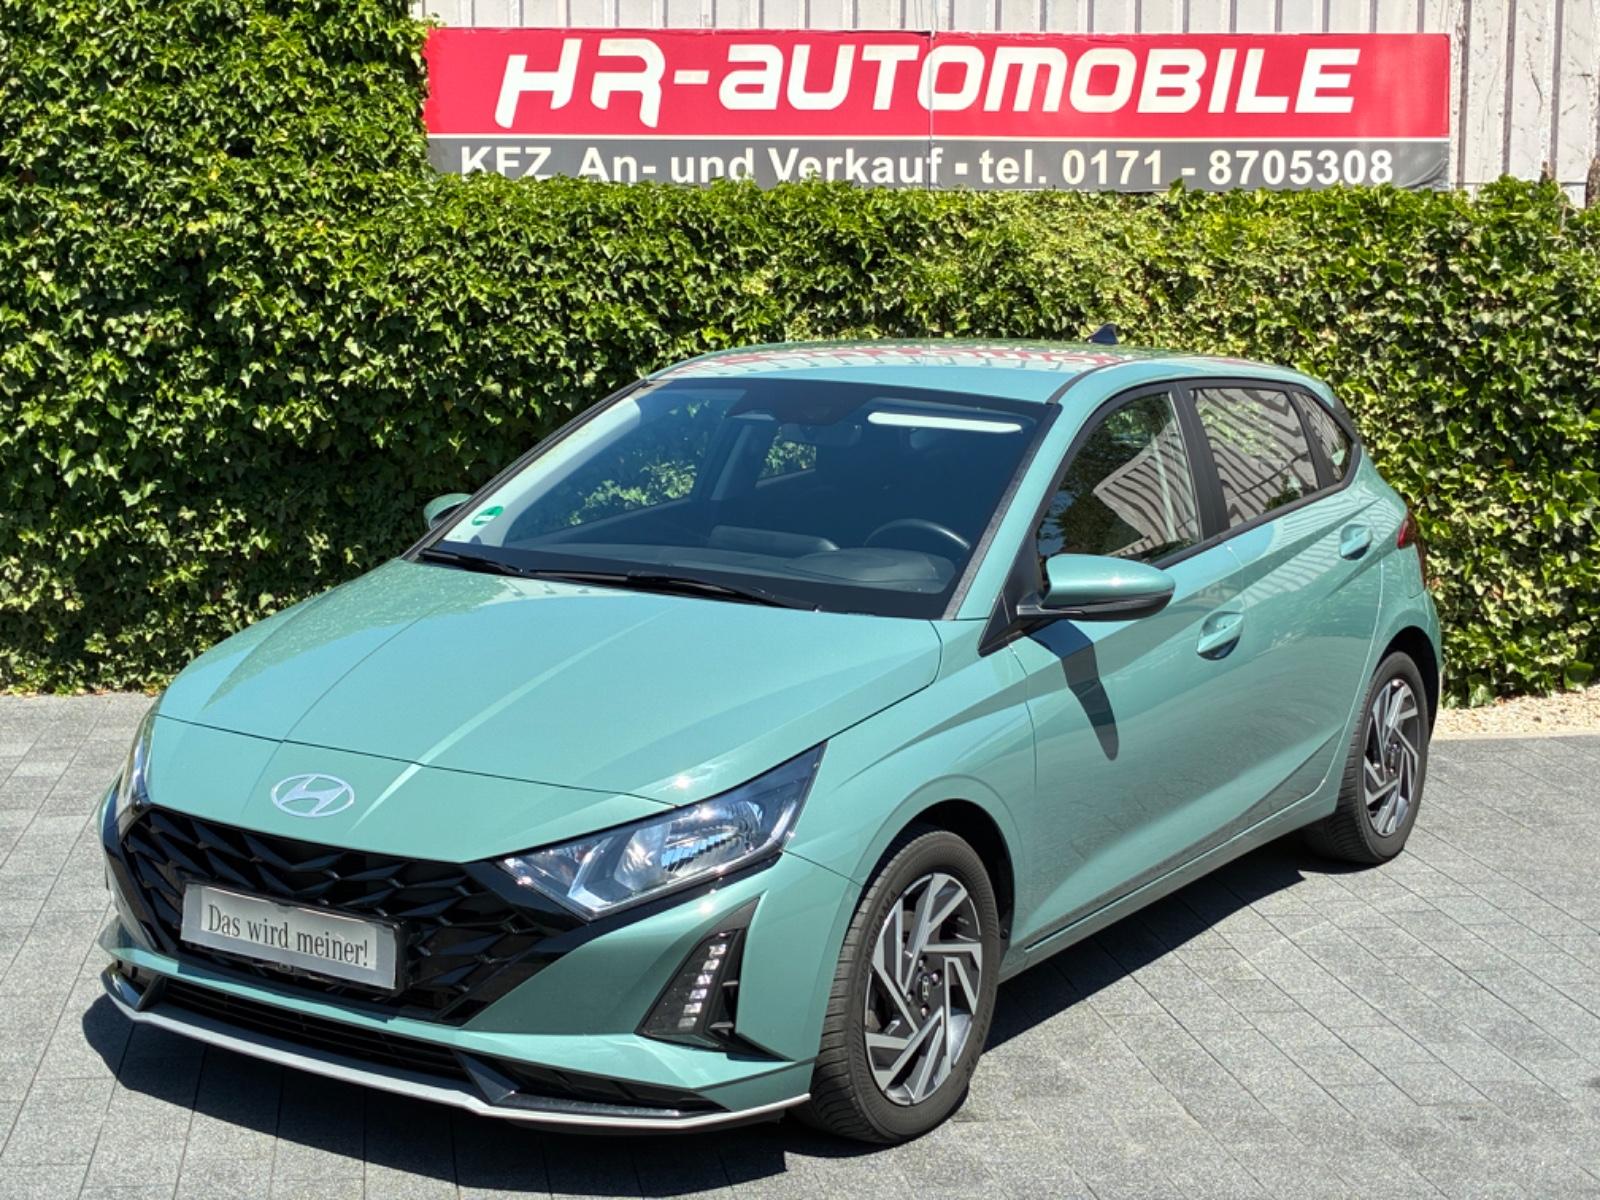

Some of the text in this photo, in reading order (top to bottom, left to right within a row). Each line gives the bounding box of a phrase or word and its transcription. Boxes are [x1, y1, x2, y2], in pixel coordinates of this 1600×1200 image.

[461, 146, 553, 183] KFZ
[577, 147, 657, 184] An-
[671, 147, 755, 184] und
[767, 147, 944, 184] Verkauf
[978, 149, 1047, 184] tel.
[1061, 149, 1162, 185] 0171
[1207, 149, 1393, 185] 8705308
[208, 904, 368, 967] Das wird meiner!
